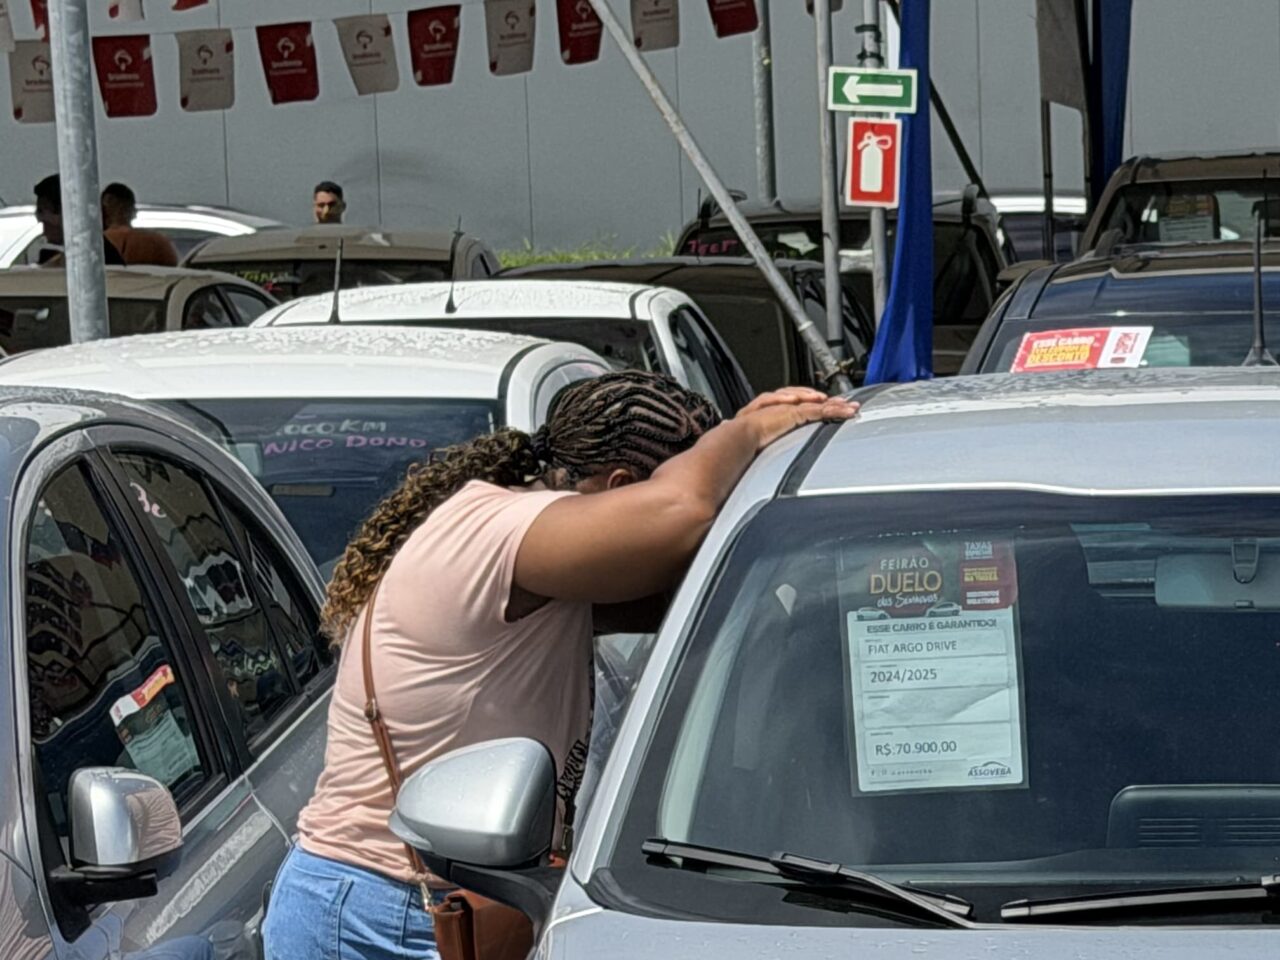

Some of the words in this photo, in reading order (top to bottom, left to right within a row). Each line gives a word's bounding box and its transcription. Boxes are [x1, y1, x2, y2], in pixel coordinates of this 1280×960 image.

[345, 435, 427, 448] DONO
[870, 570, 942, 594] DUELO
[868, 644, 889, 655] FIAT
[893, 642, 923, 654] ARGO
[926, 640, 957, 652] DRIVE
[870, 668, 937, 683] 2024/2025
